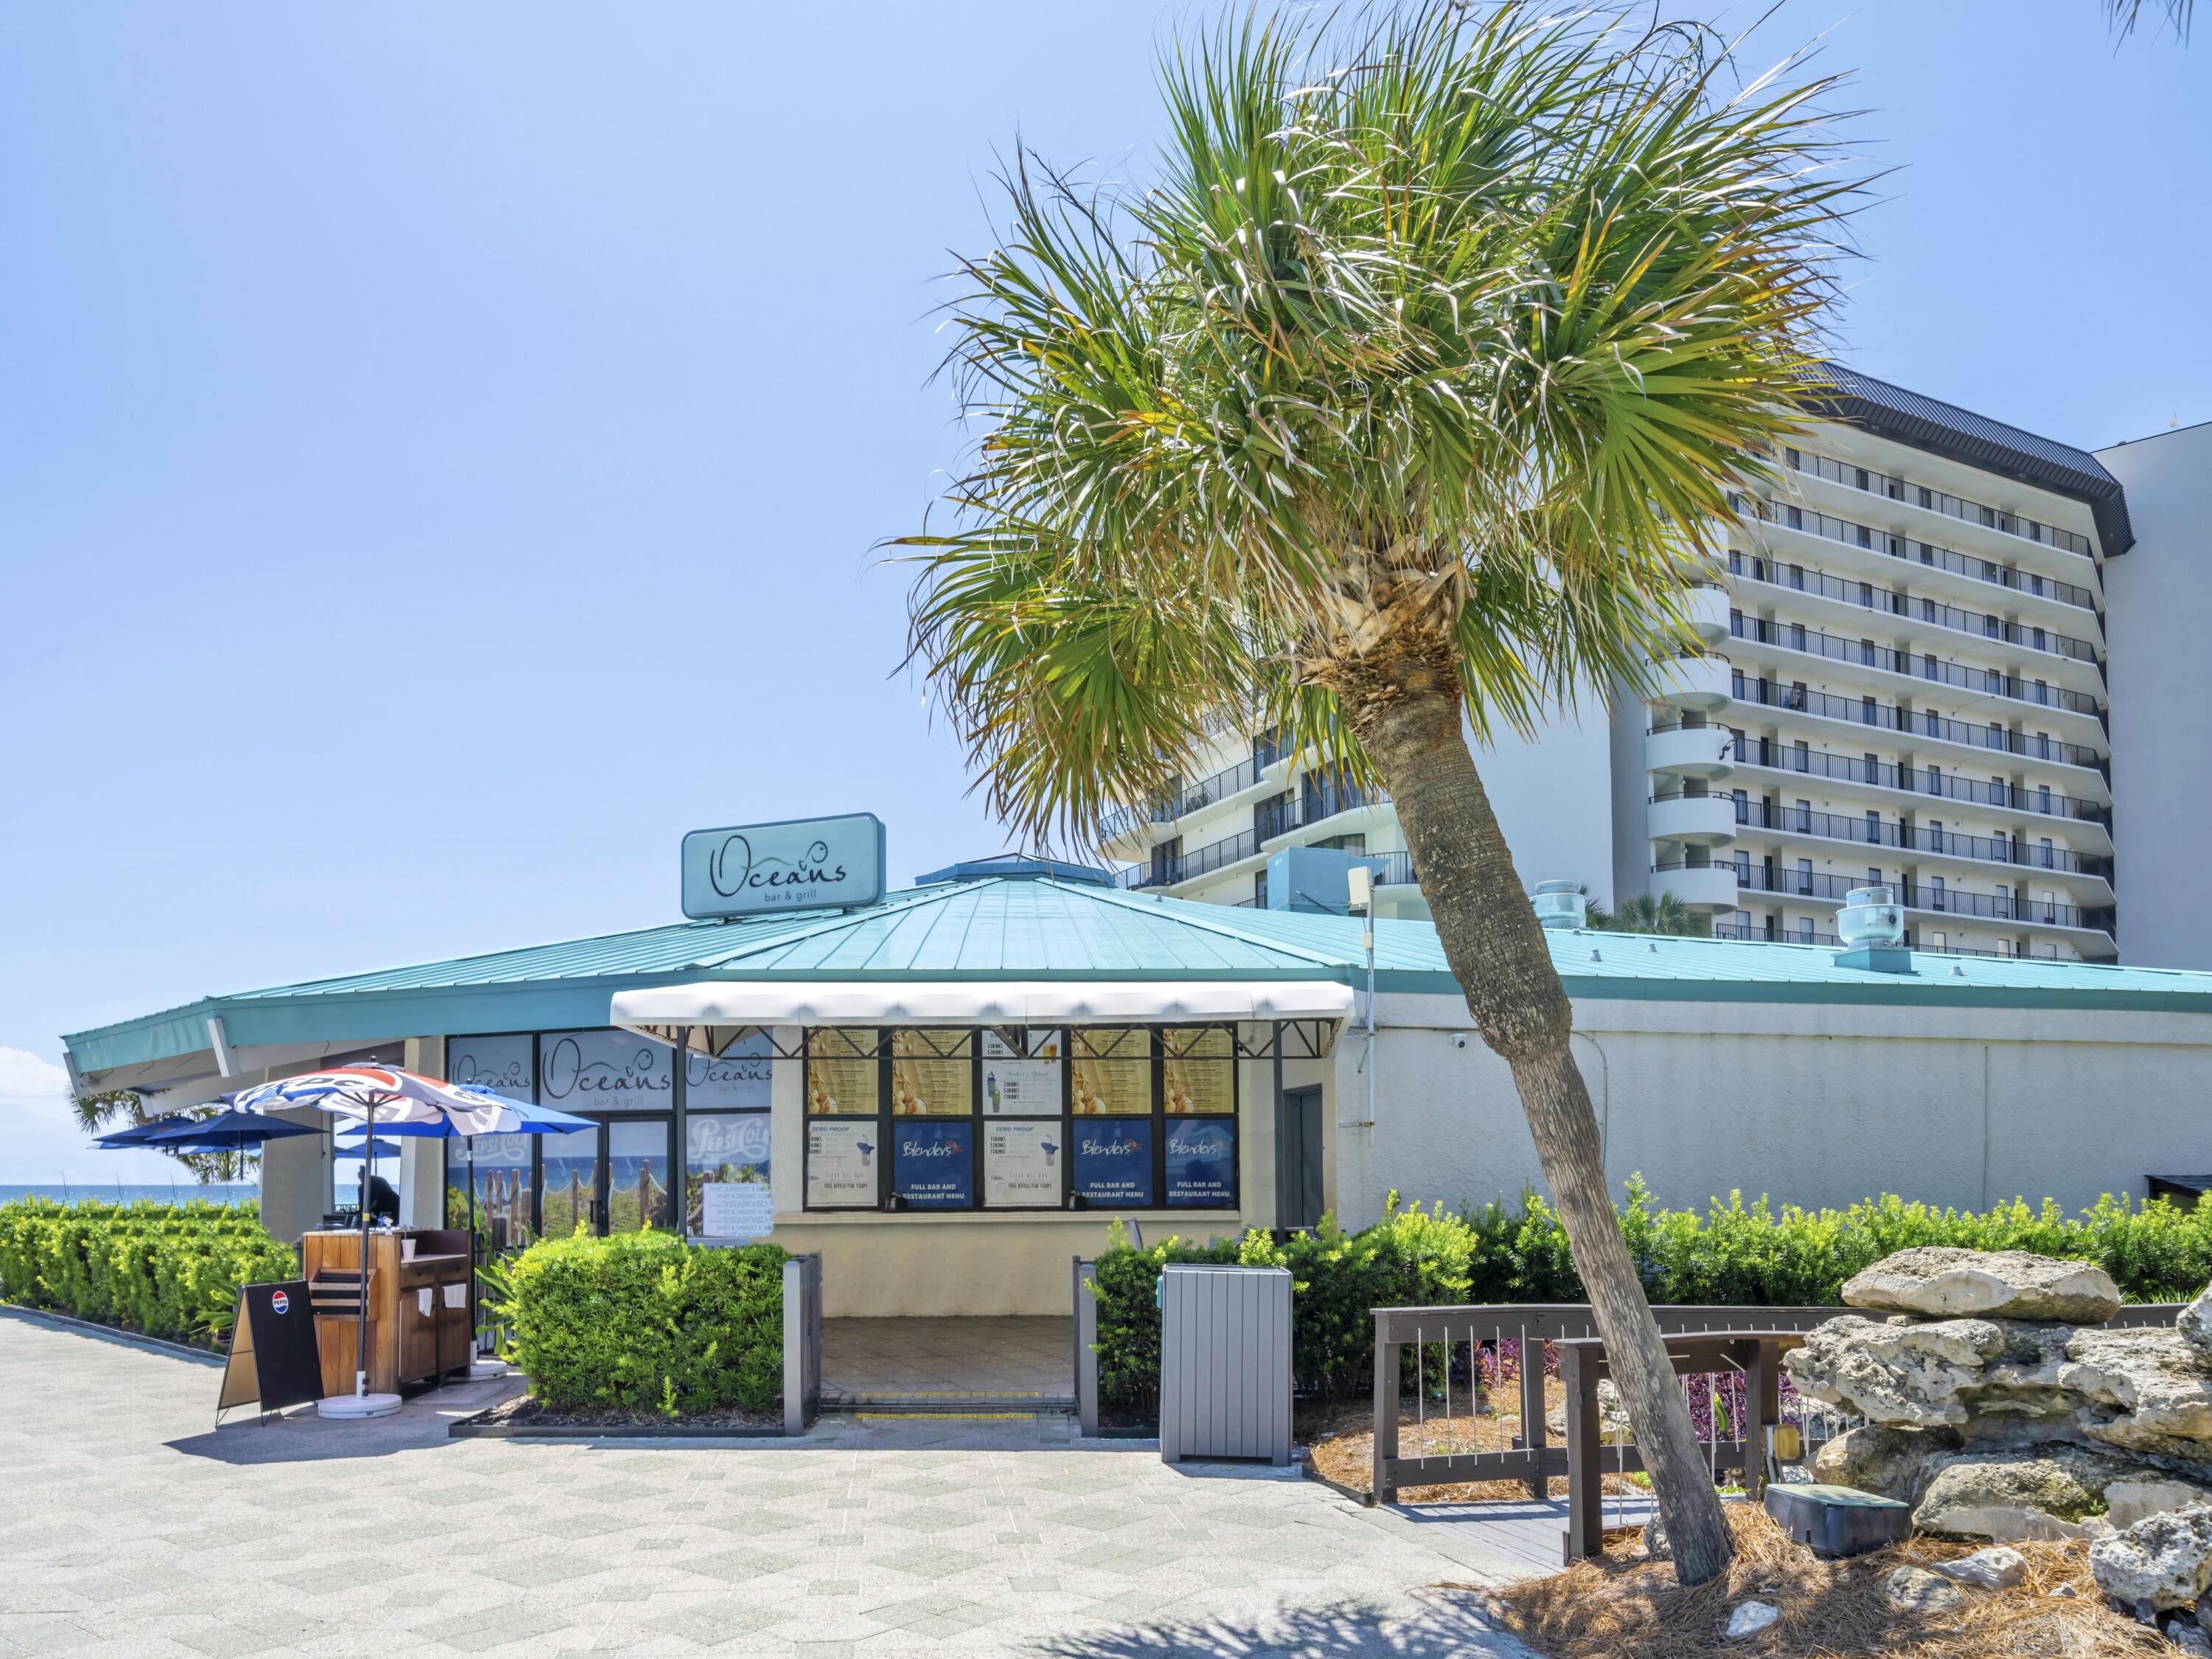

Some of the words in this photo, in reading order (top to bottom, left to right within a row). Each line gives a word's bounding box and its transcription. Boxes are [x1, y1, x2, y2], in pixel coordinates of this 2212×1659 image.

[710, 835, 846, 897] Oceans
[765, 893, 780, 902] bar
[785, 891, 791, 900] &
[796, 889, 816, 902] grill
[542, 1037, 671, 1099] Oceans
[686, 1054, 772, 1087] Oceans
[740, 1084, 754, 1092] grill
[594, 1097, 608, 1106] bar
[613, 1096, 619, 1106] &
[624, 1096, 643, 1107] grill
[902, 1140, 952, 1157] Blenders
[1081, 1138, 1133, 1155] Blenders
[1169, 1138, 1218, 1155] Blenders
